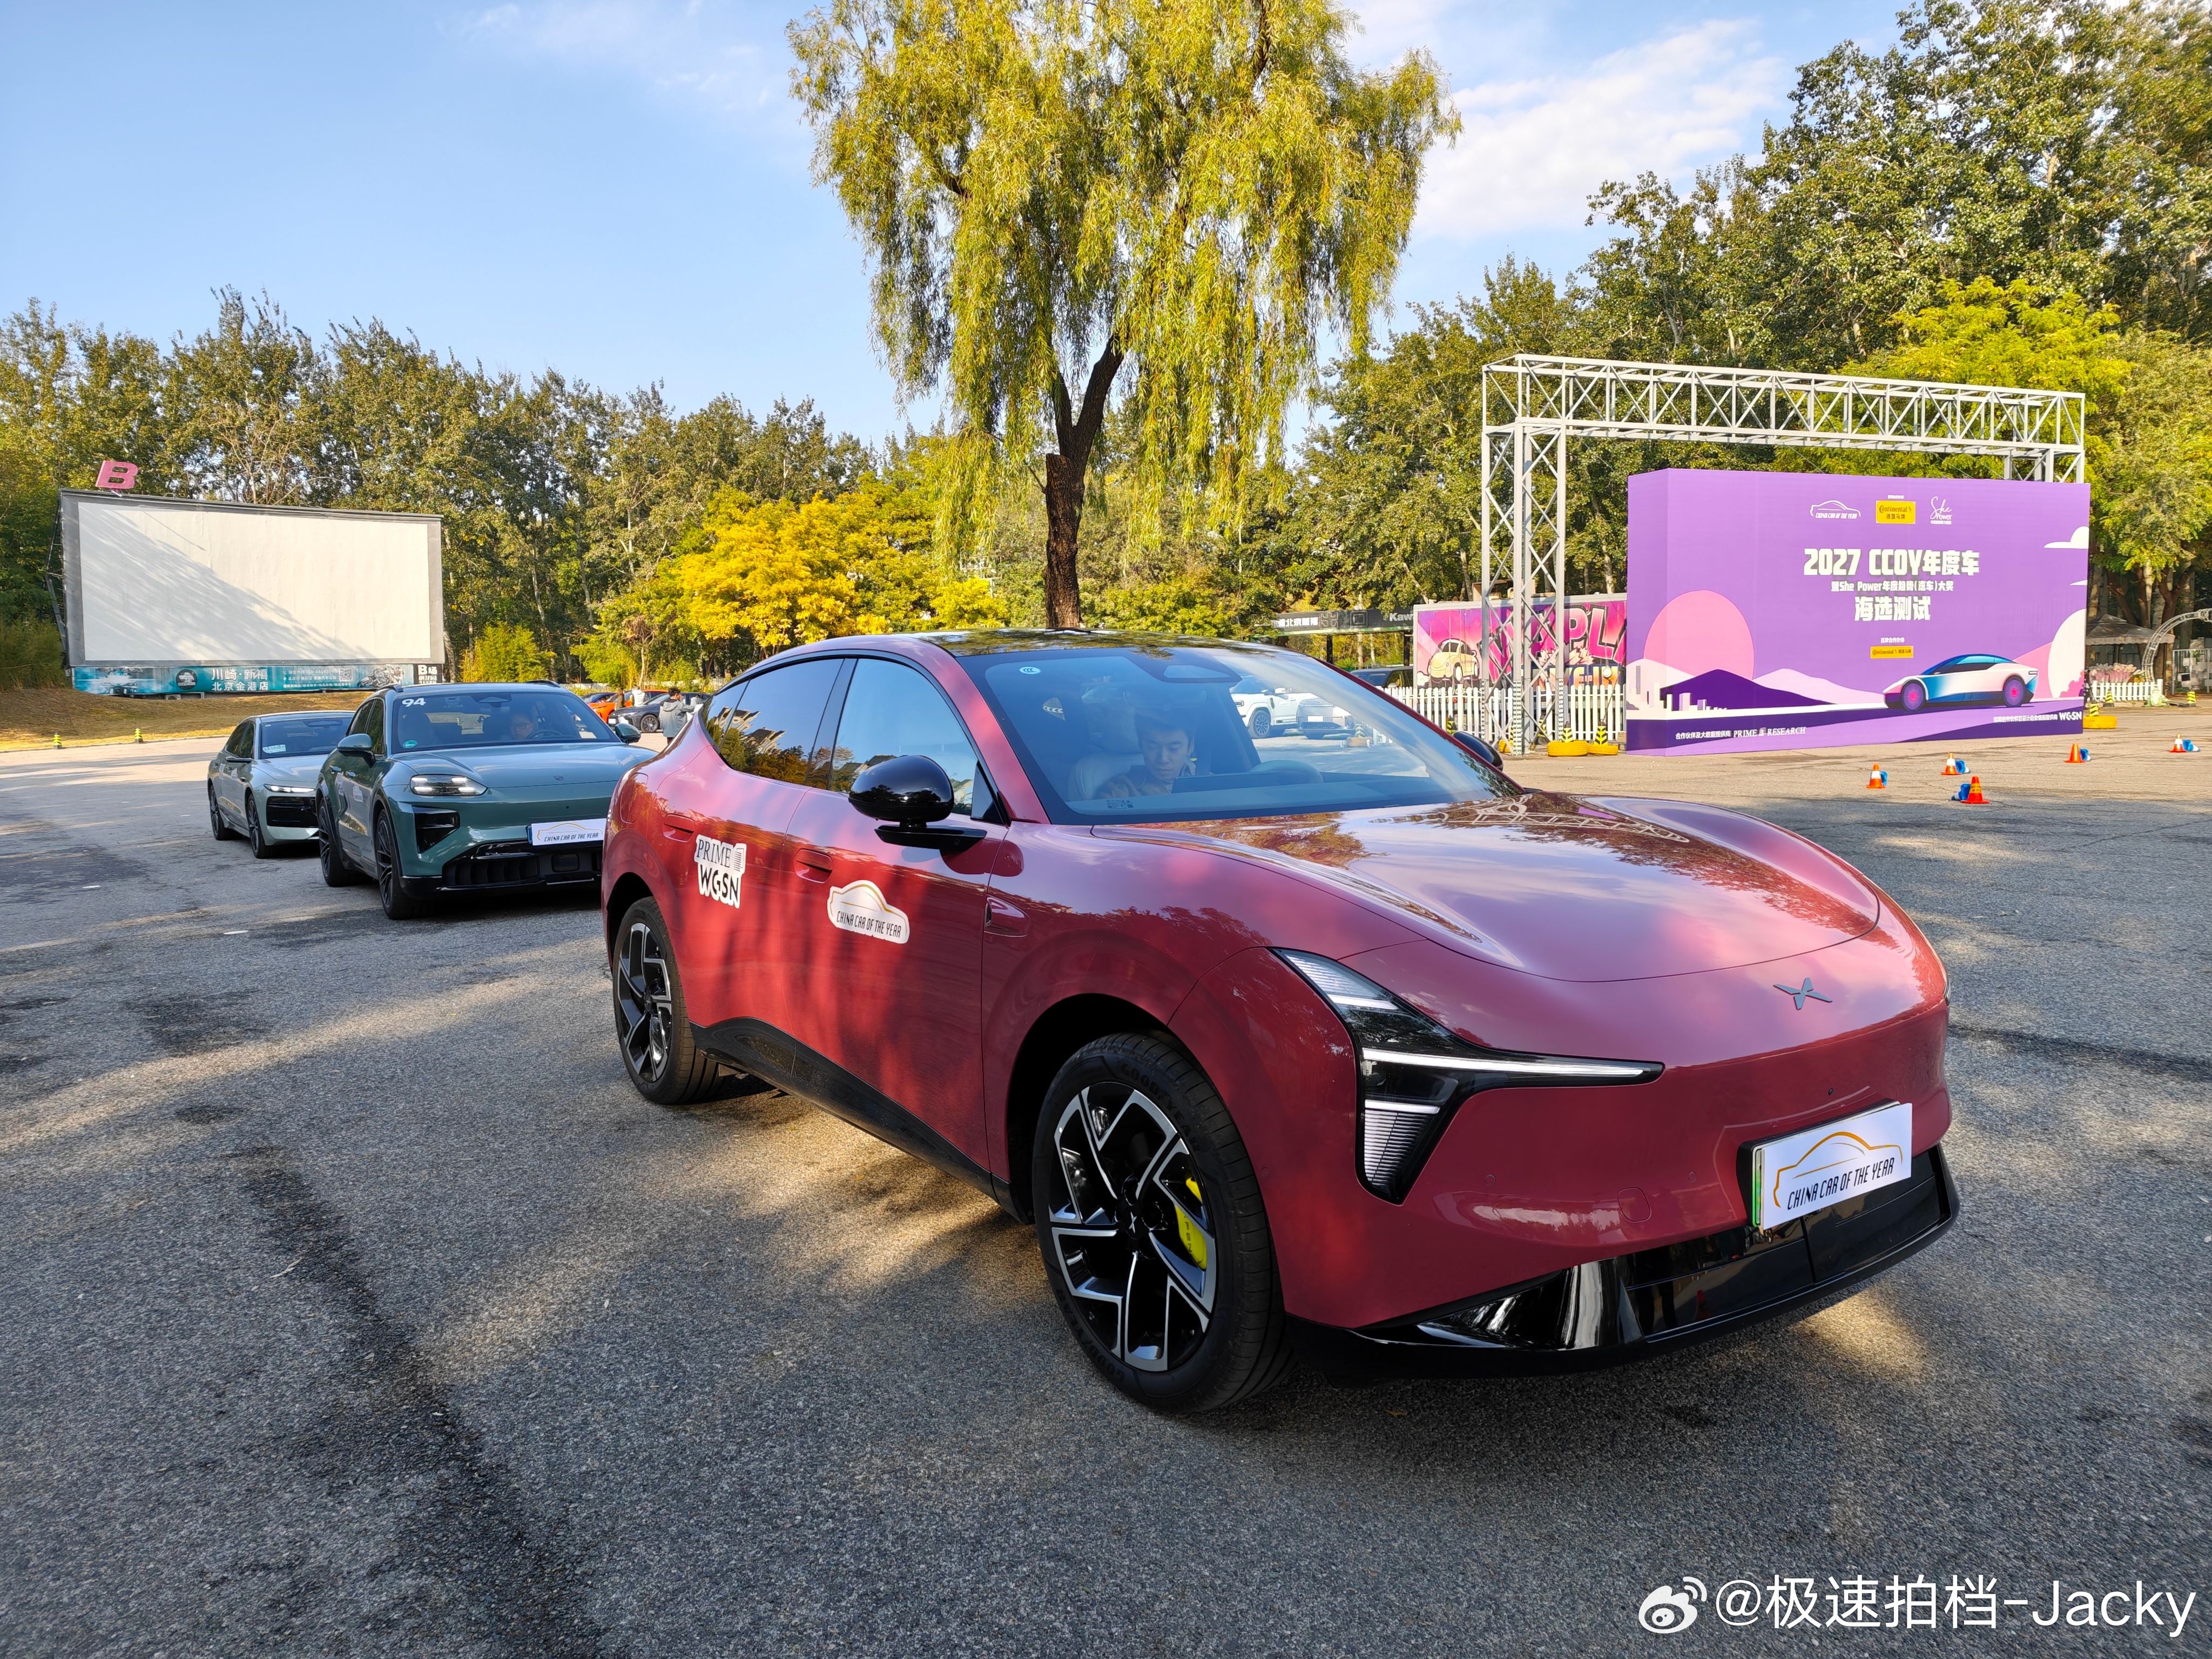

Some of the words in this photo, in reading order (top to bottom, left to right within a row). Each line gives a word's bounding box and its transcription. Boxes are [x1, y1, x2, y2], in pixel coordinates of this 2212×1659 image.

[95, 460, 138, 489] B
[1879, 505, 1907, 514] Continental
[1930, 496, 1952, 520] She
[1804, 548, 1861, 576] 2027
[1869, 549, 1980, 576] CCOY年度车
[1854, 595, 1931, 622] 海选测试
[212, 681, 269, 691] 北京金港店
[402, 698, 426, 707] 94
[2059, 711, 2082, 721] WGSN
[1733, 729, 1758, 738] PRIME
[1767, 726, 1806, 736] RESEARCH
[697, 839, 731, 868] PRIME
[700, 865, 739, 903] WGSN
[837, 911, 853, 927] CHINA
[854, 916, 865, 930] CAR
[867, 918, 875, 930] OF
[875, 920, 885, 934] THE
[886, 922, 902, 938] YEAR
[1787, 1183, 1818, 1210] CHINA
[1819, 1176, 1839, 1198] CAR
[1840, 1171, 1853, 1191] OF
[1853, 1165, 1870, 1186] THE
[1872, 1157, 1895, 1181] YEAR
